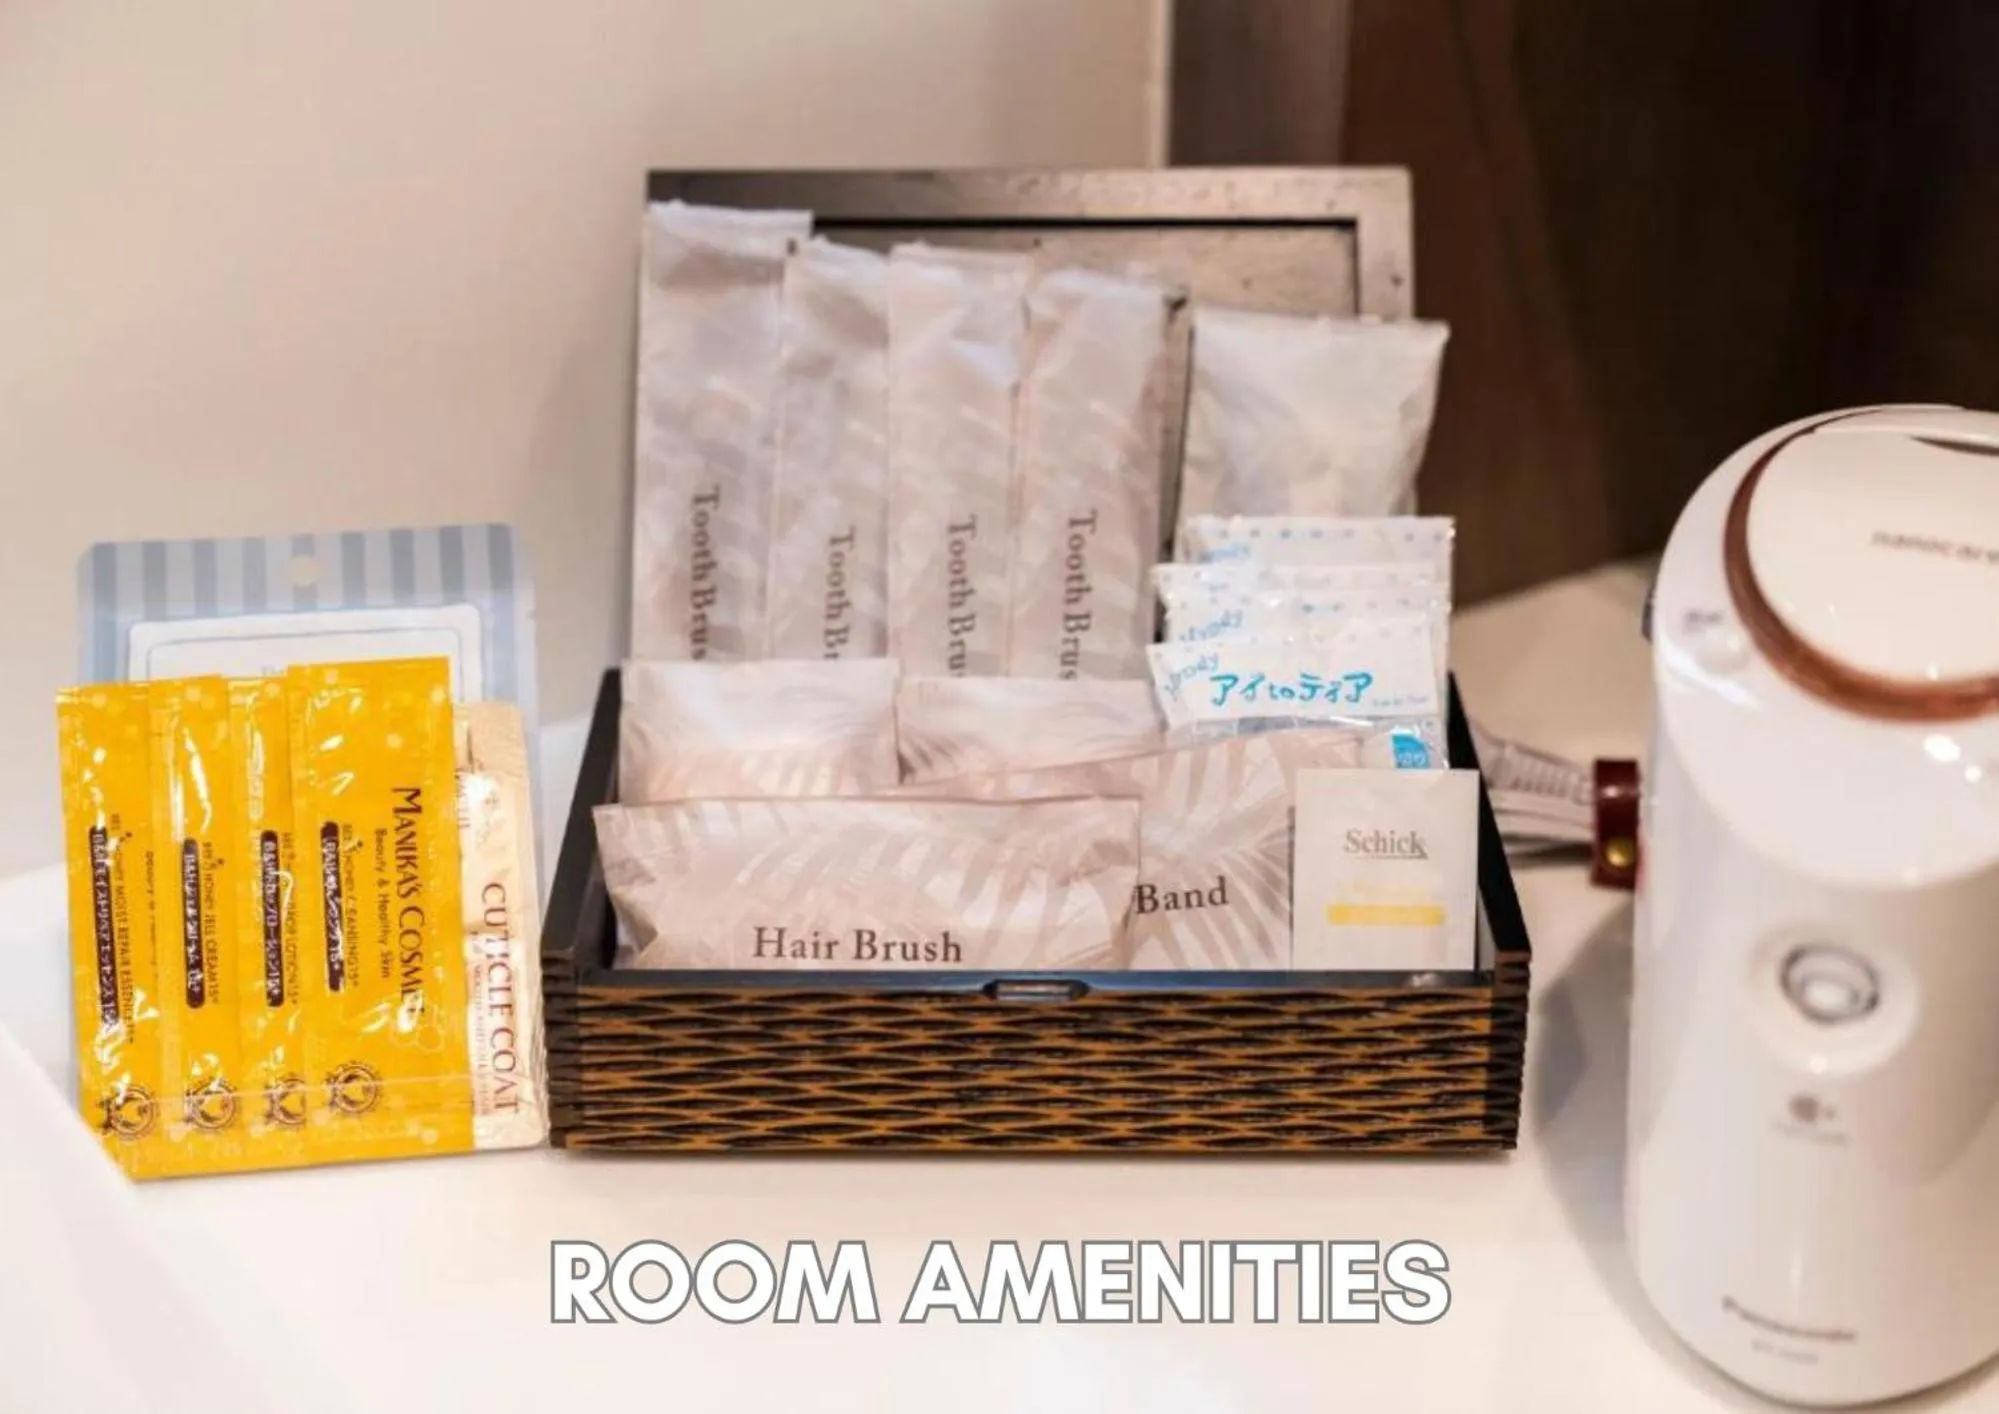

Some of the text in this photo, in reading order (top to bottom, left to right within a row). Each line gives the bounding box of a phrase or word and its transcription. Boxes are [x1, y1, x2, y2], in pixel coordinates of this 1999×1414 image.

[691, 482, 721, 582] Tooth
[1065, 507, 1098, 607] Tooth
[824, 523, 858, 619] Tooth
[947, 512, 978, 609] Tooth
[375, 827, 389, 872] Beauty
[1344, 829, 1427, 856] Schick
[376, 893, 391, 945] Healthy
[1135, 876, 1229, 914] Band
[380, 951, 393, 979] Skin
[753, 926, 963, 963] Hair Brush
[482, 882, 519, 1114] CUTICLE COAT
